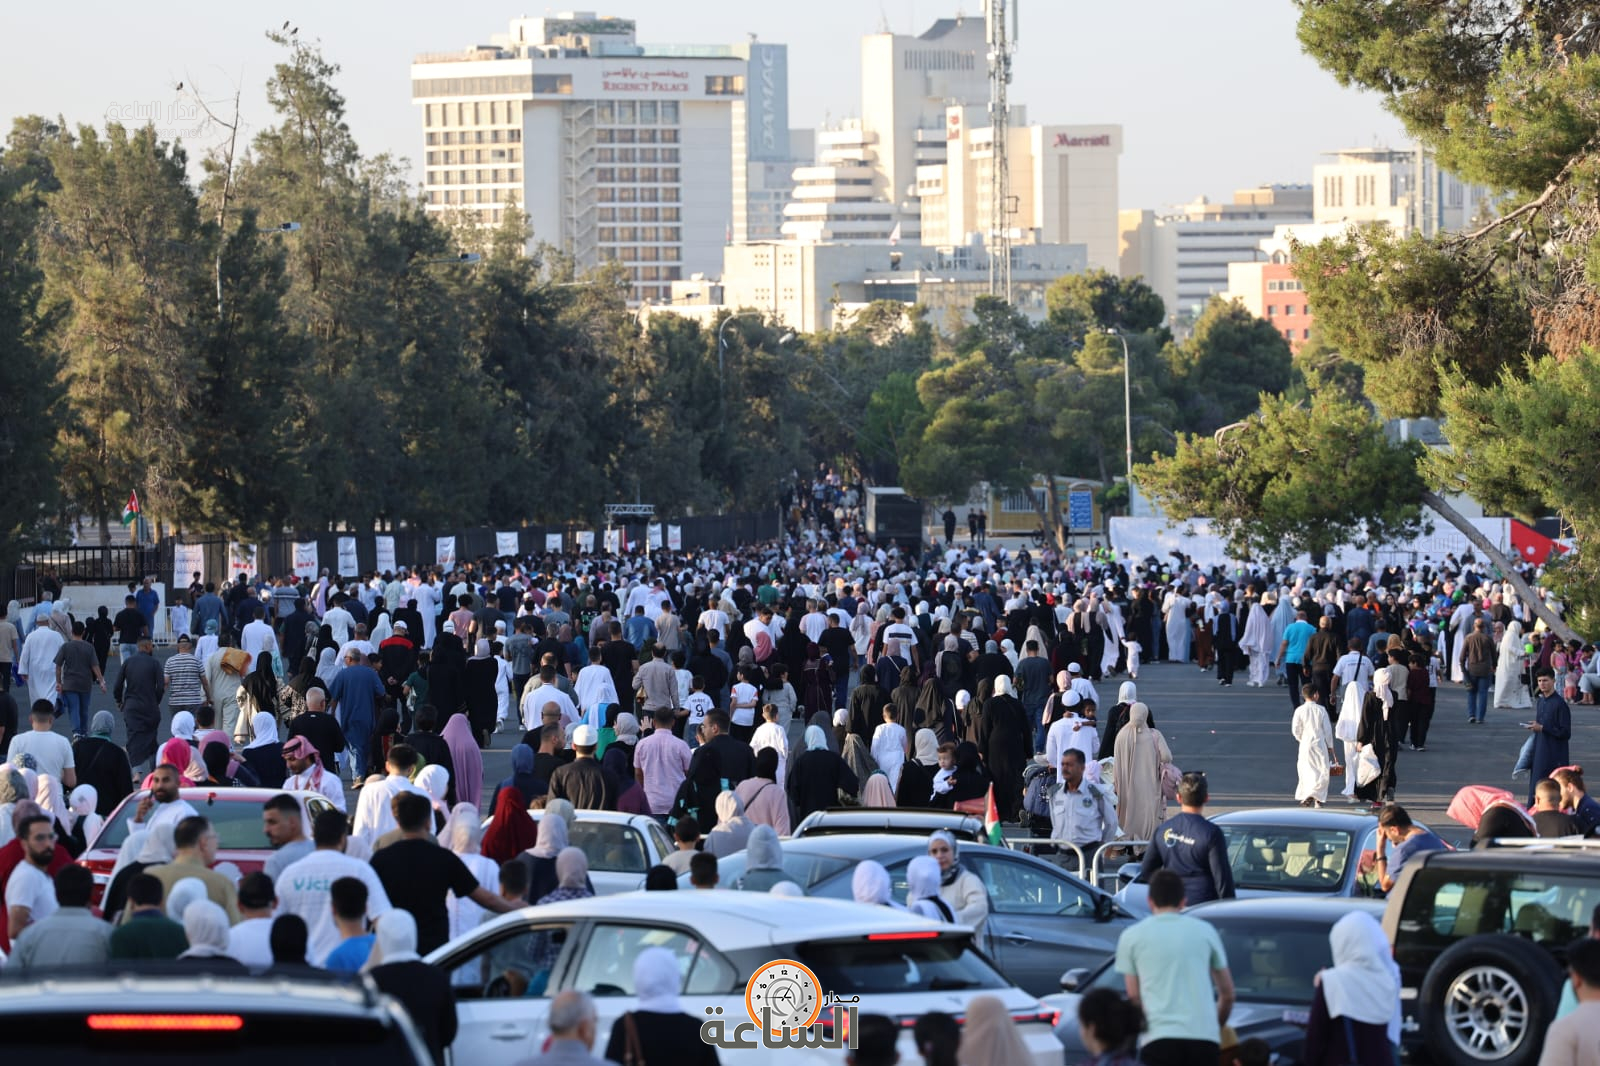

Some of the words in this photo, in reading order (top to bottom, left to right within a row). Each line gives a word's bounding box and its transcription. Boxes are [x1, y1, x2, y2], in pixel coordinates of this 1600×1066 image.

[761, 47, 776, 150] DAMAC
[1053, 133, 1111, 148] Marriott
[695, 703, 705, 717] 9
